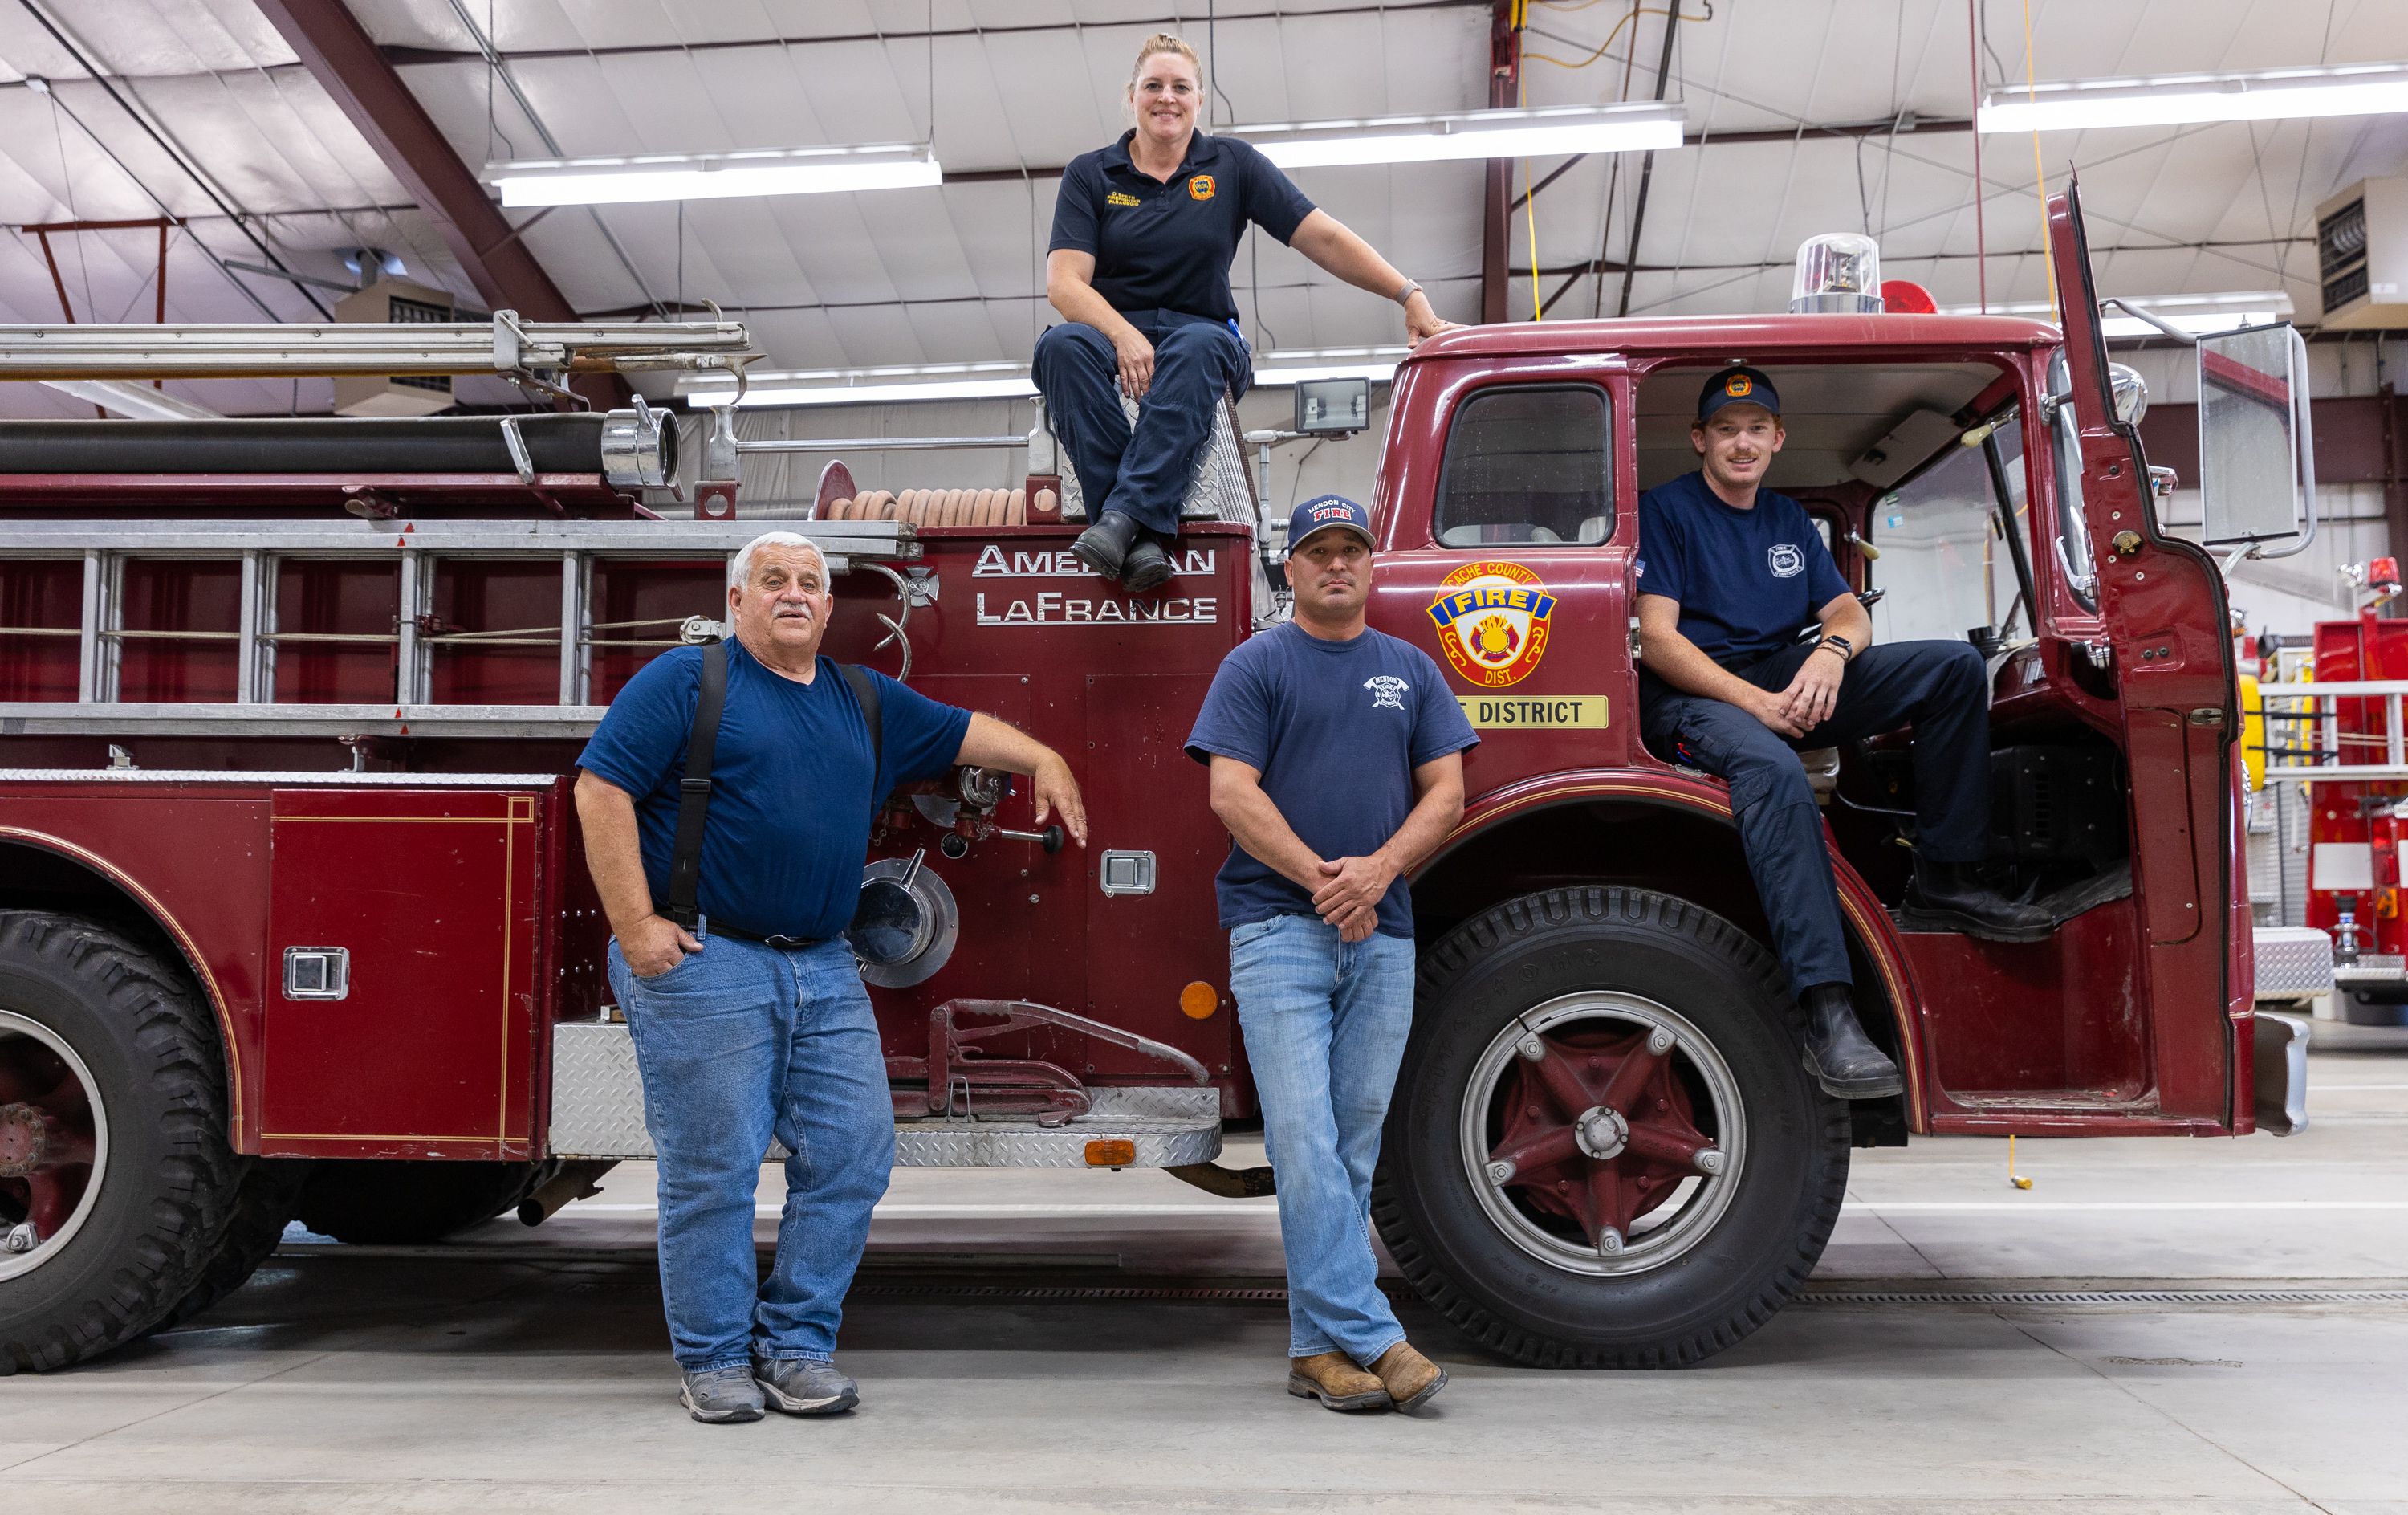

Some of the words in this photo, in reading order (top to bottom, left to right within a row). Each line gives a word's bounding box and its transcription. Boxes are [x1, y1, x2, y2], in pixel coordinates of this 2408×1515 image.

[1308, 499, 1339, 514] MENDON
[1341, 502, 1357, 514] CITY
[1314, 507, 1352, 522] FIRE
[1447, 564, 1483, 588] CACHE
[1487, 562, 1534, 585] COUNTY
[1453, 588, 1531, 613] FIRE
[1375, 675, 1397, 685] MENDON
[1484, 668, 1517, 685] DIST.
[1479, 701, 1583, 723] DISTRICT
